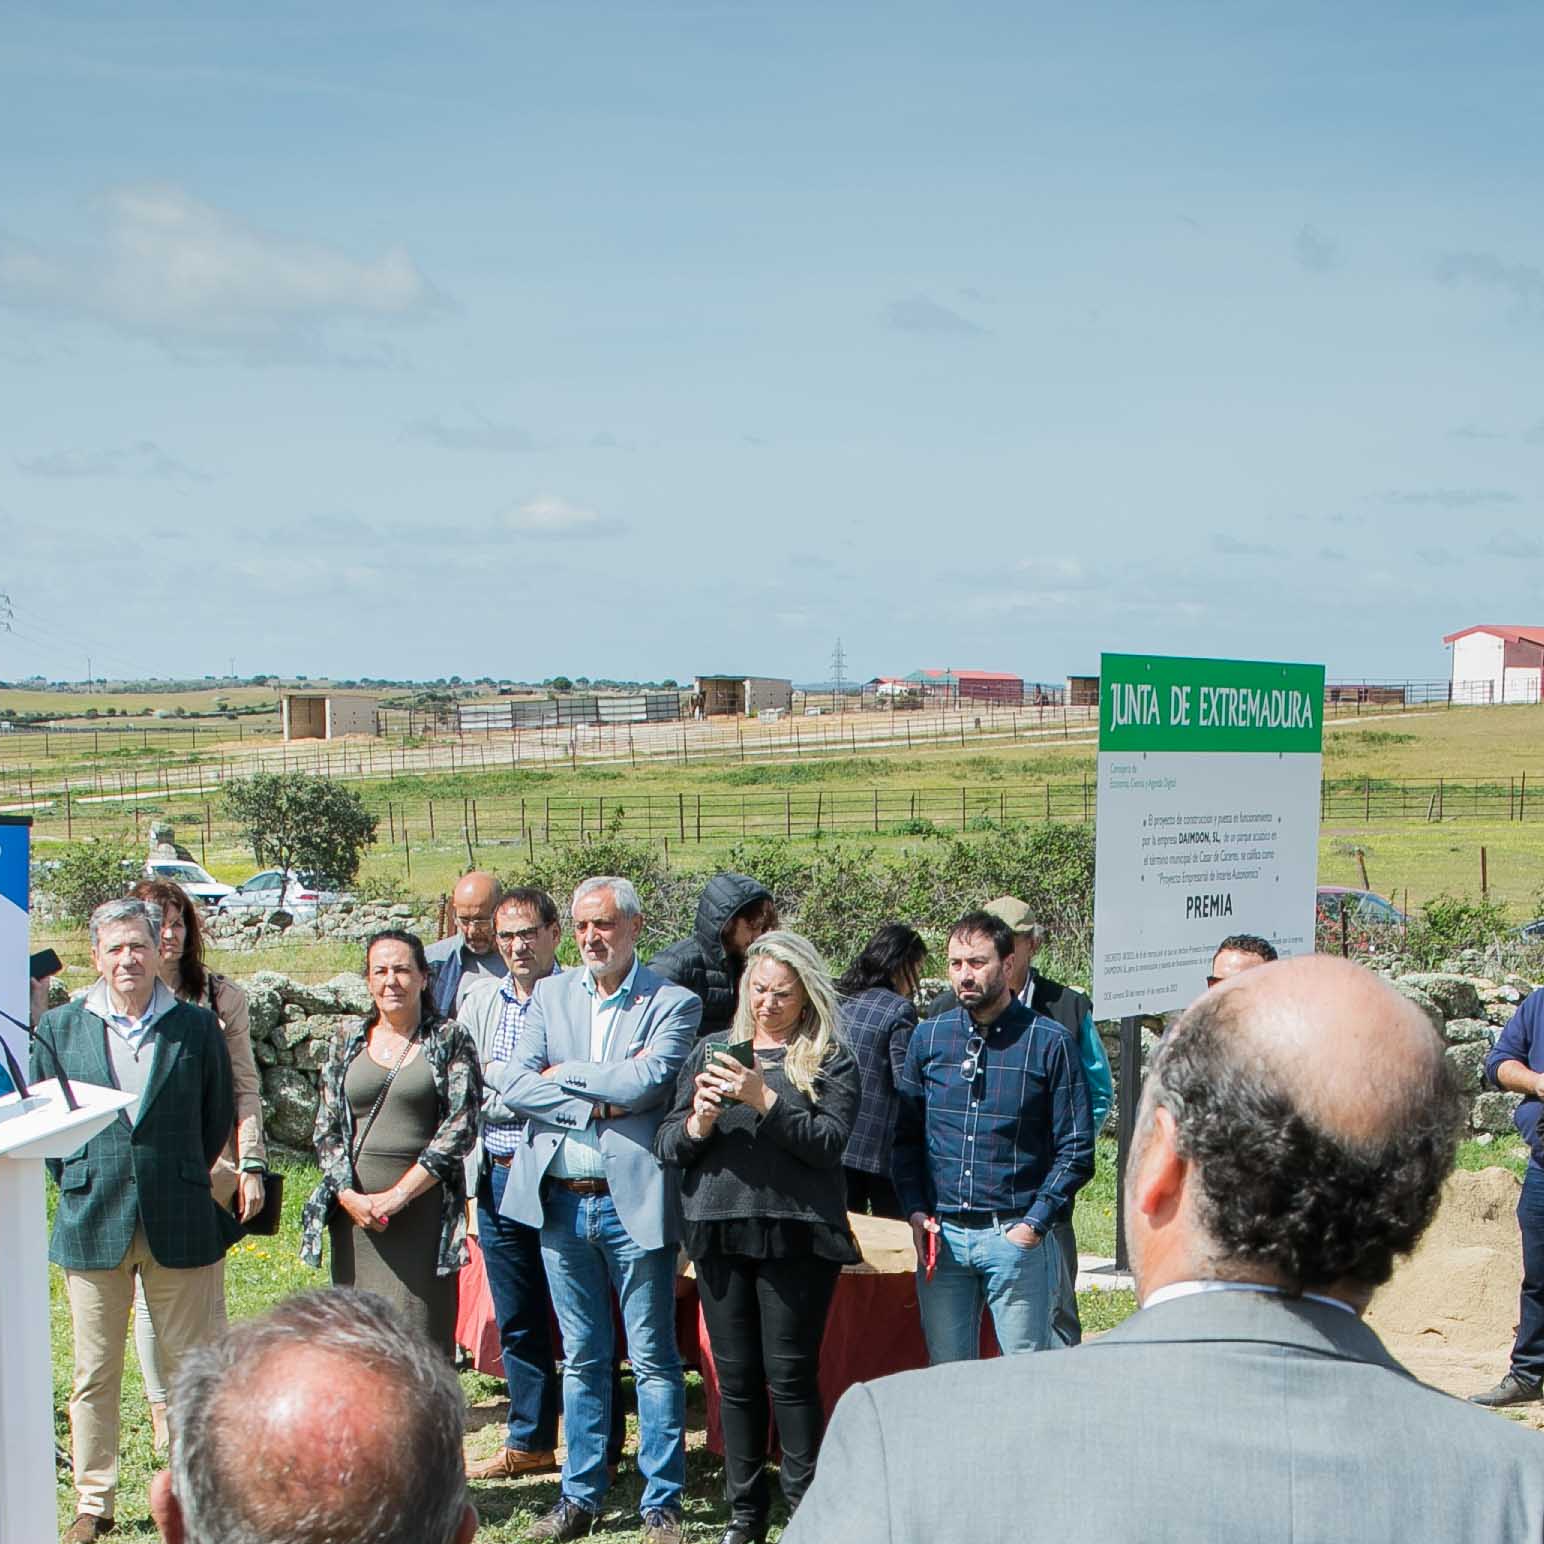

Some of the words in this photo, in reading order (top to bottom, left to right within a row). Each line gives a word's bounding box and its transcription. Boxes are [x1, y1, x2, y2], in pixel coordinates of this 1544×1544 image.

[1110, 683, 1161, 732] JUNTA
[1170, 685, 1191, 726] DE
[1199, 686, 1313, 728] EXTREMADURA
[1186, 893, 1233, 919] PREMIA
